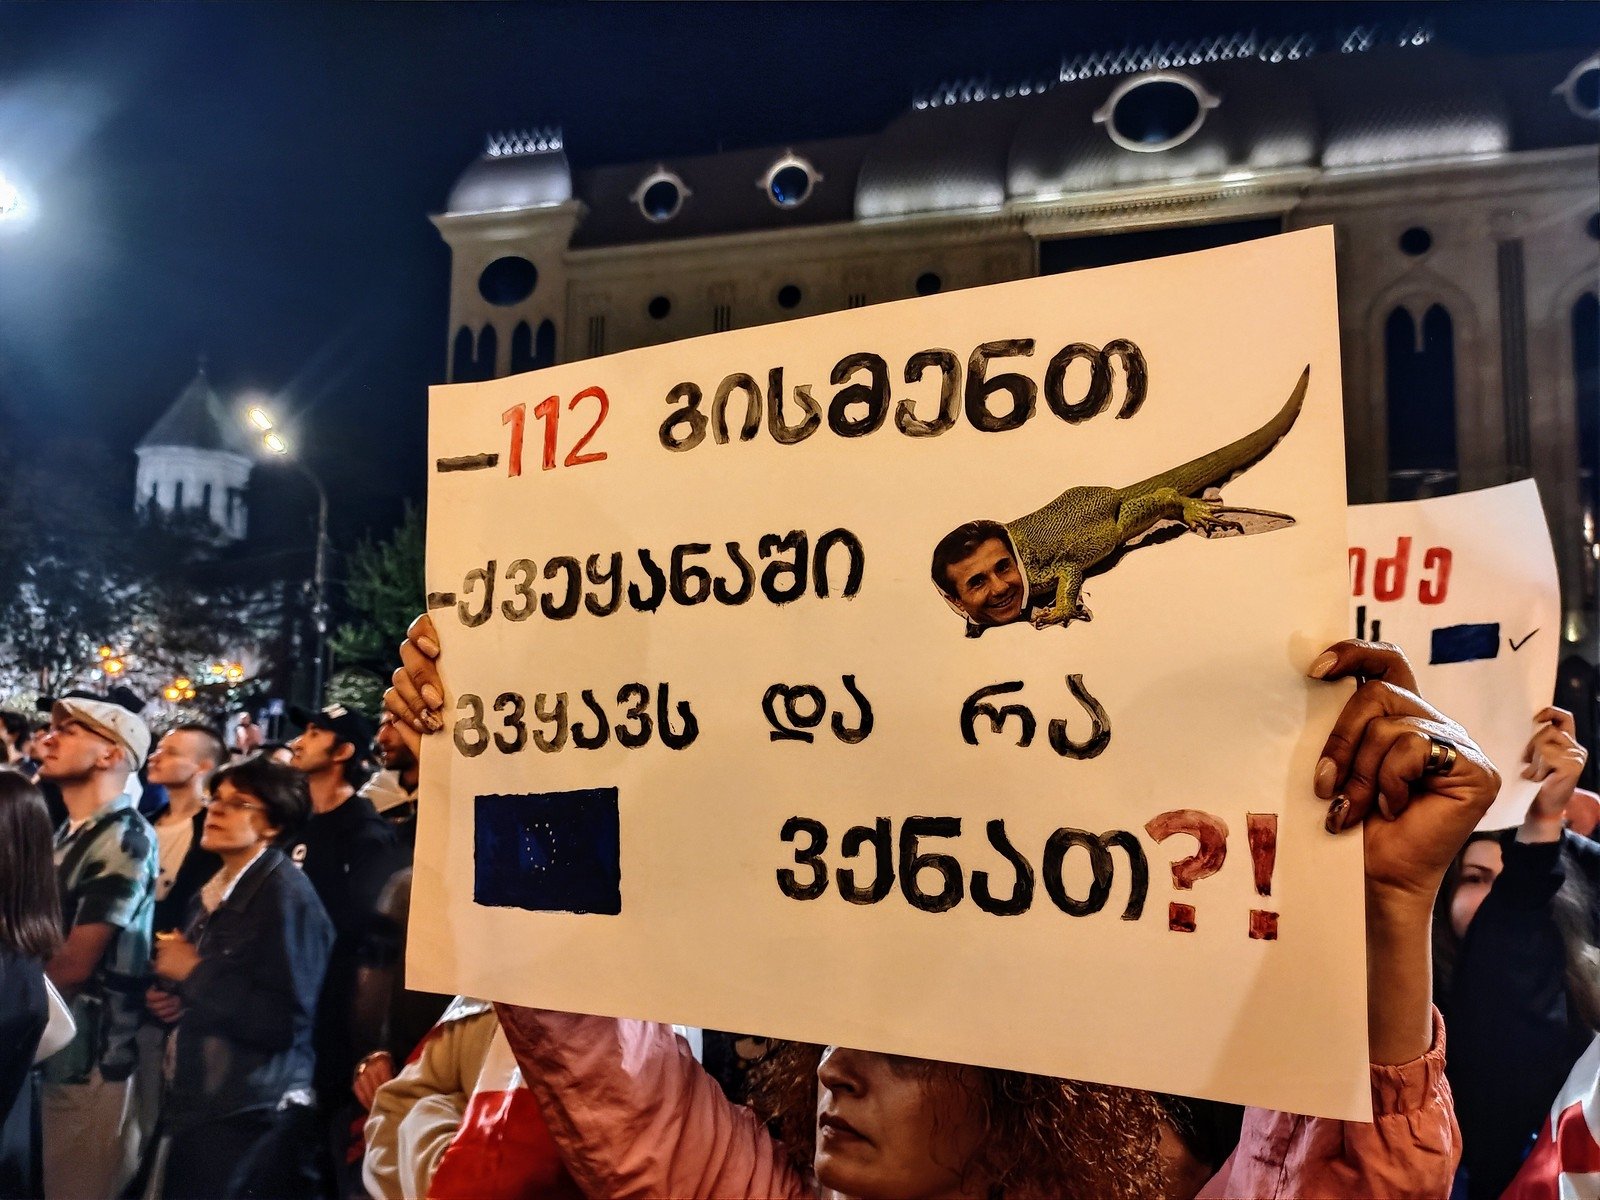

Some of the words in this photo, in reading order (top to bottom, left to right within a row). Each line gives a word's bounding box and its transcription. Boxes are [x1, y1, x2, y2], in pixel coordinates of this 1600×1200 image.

[658, 338, 1148, 452] გისმენთ
[453, 682, 700, 757] გვყავს
[761, 674, 874, 744] და
[960, 673, 1112, 760] რა
